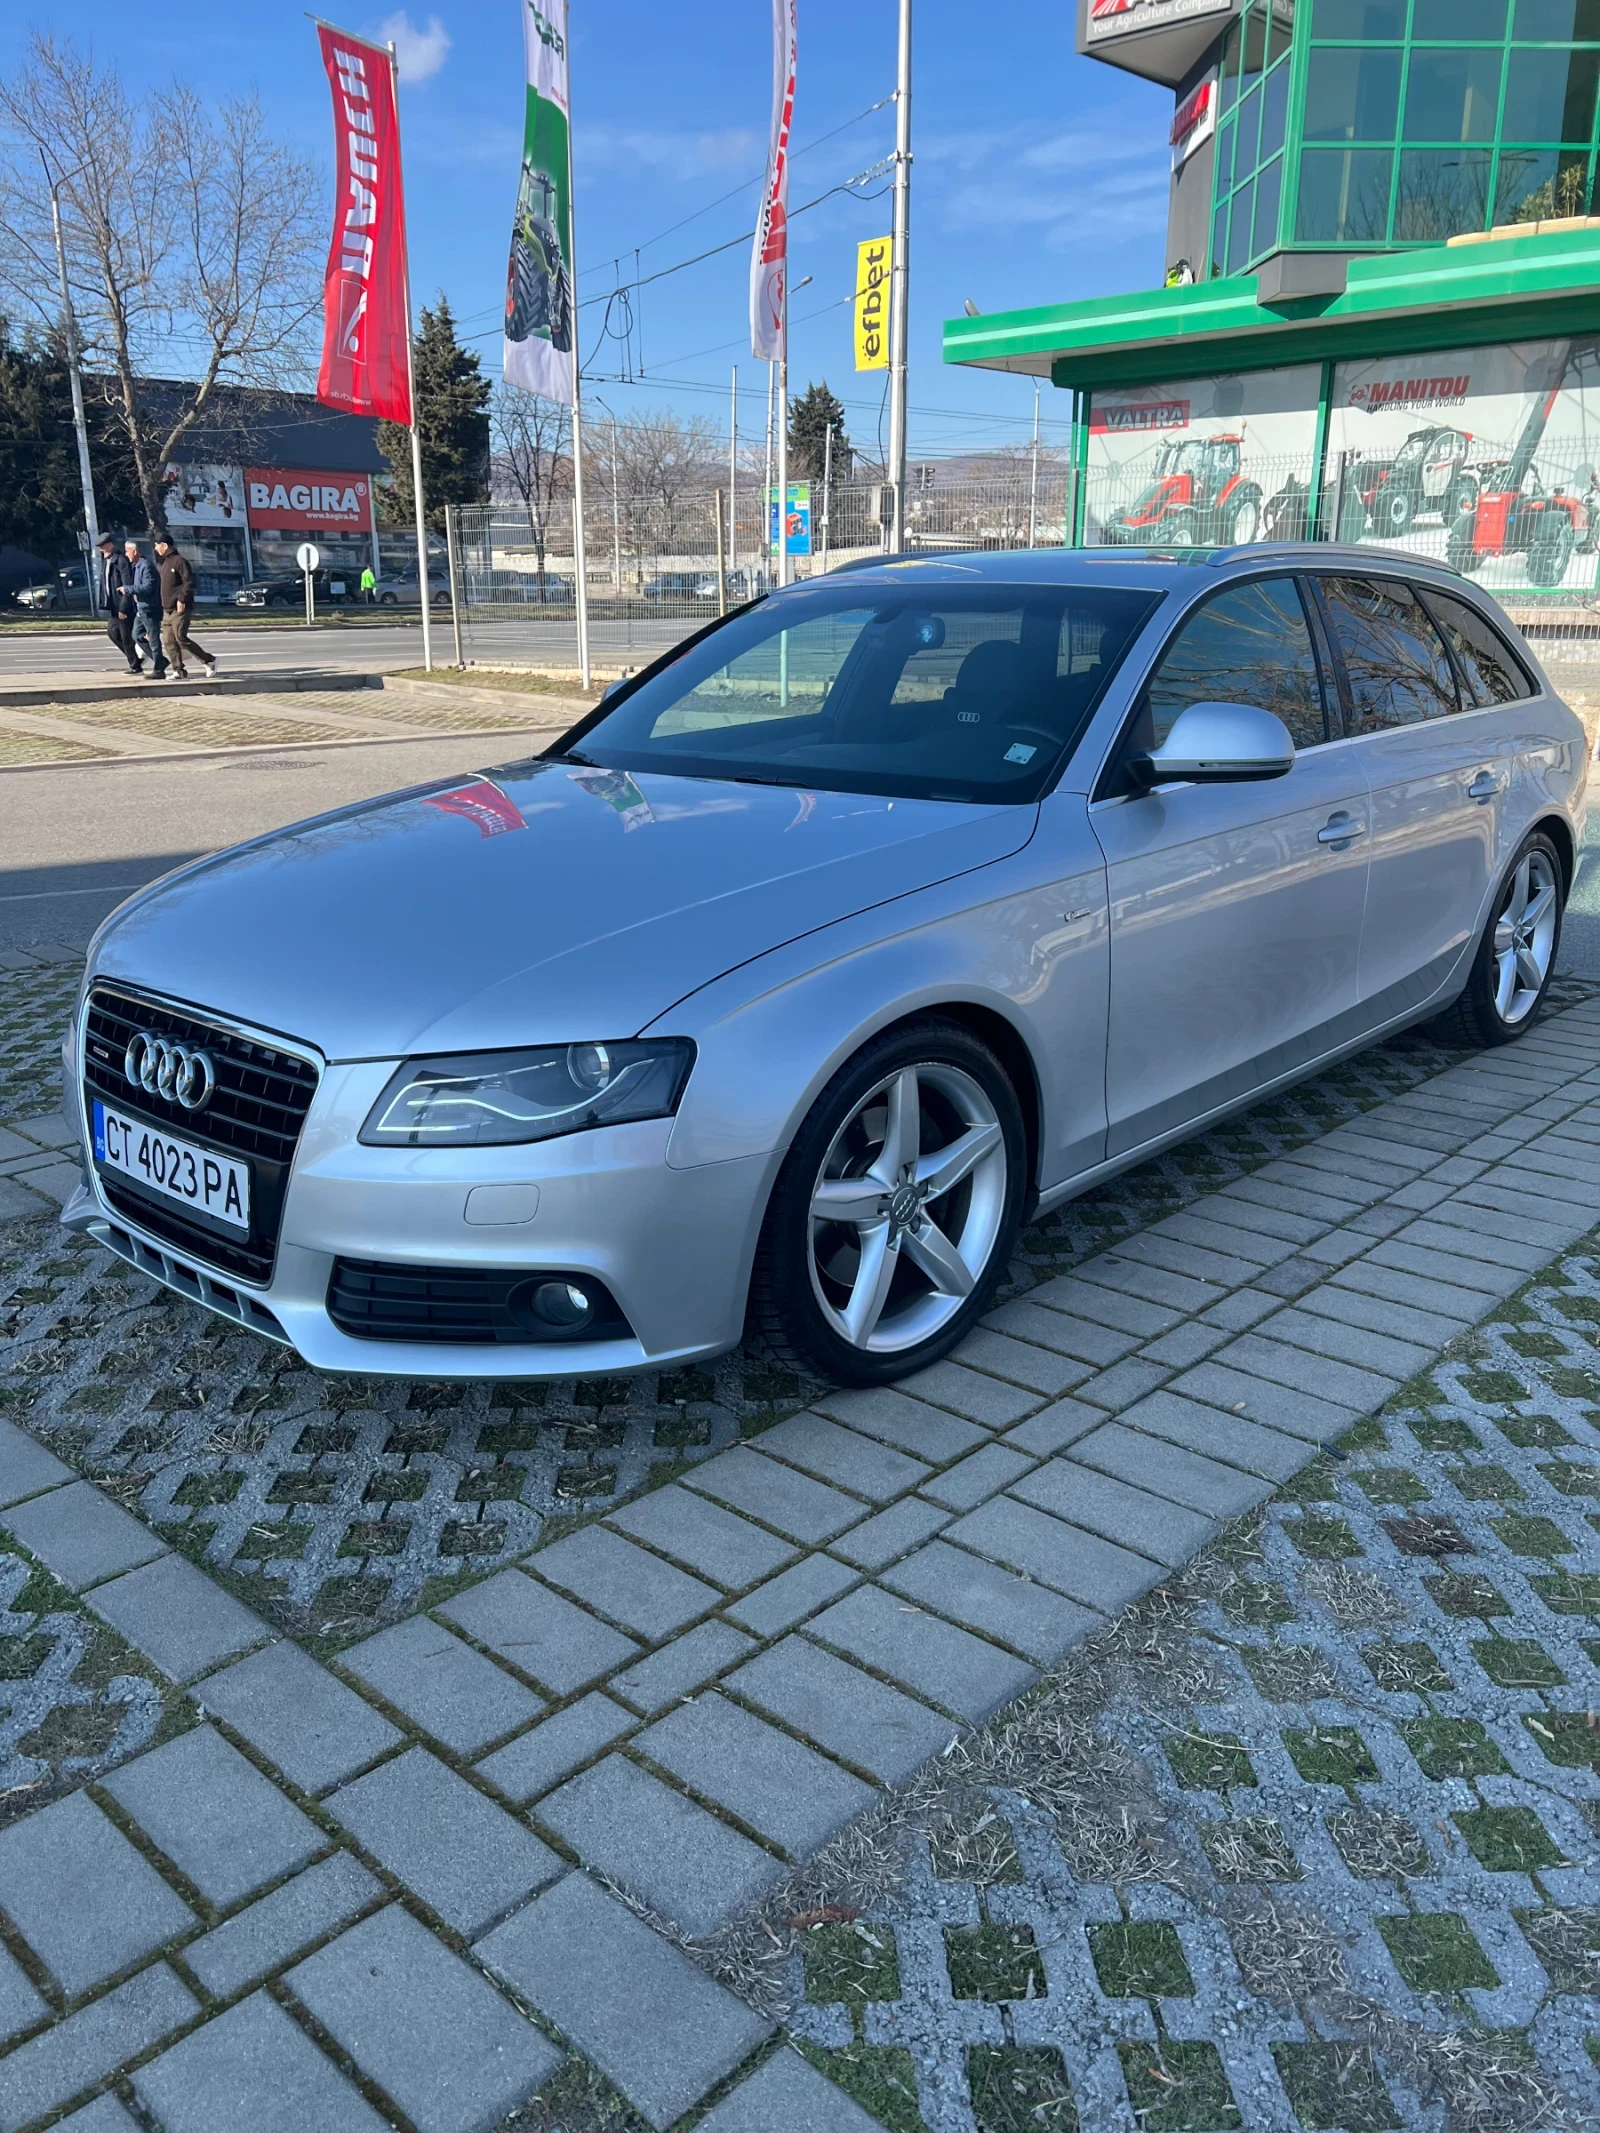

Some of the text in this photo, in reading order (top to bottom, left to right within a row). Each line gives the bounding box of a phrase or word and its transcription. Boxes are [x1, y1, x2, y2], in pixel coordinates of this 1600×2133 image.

[1093, 20, 1114, 34] Your
[1116, 7, 1171, 28] Agriculture
[1369, 375, 1471, 403] MANITOU
[1104, 404, 1184, 431] VALTRA
[1366, 397, 1466, 413] HANDLING YOUR WORLD
[250, 482, 360, 512] BAGIRA
[306, 512, 359, 521] www.bagira.bg
[96, 1136, 105, 1152] BG
[106, 1115, 243, 1219] CT 4023 PA
